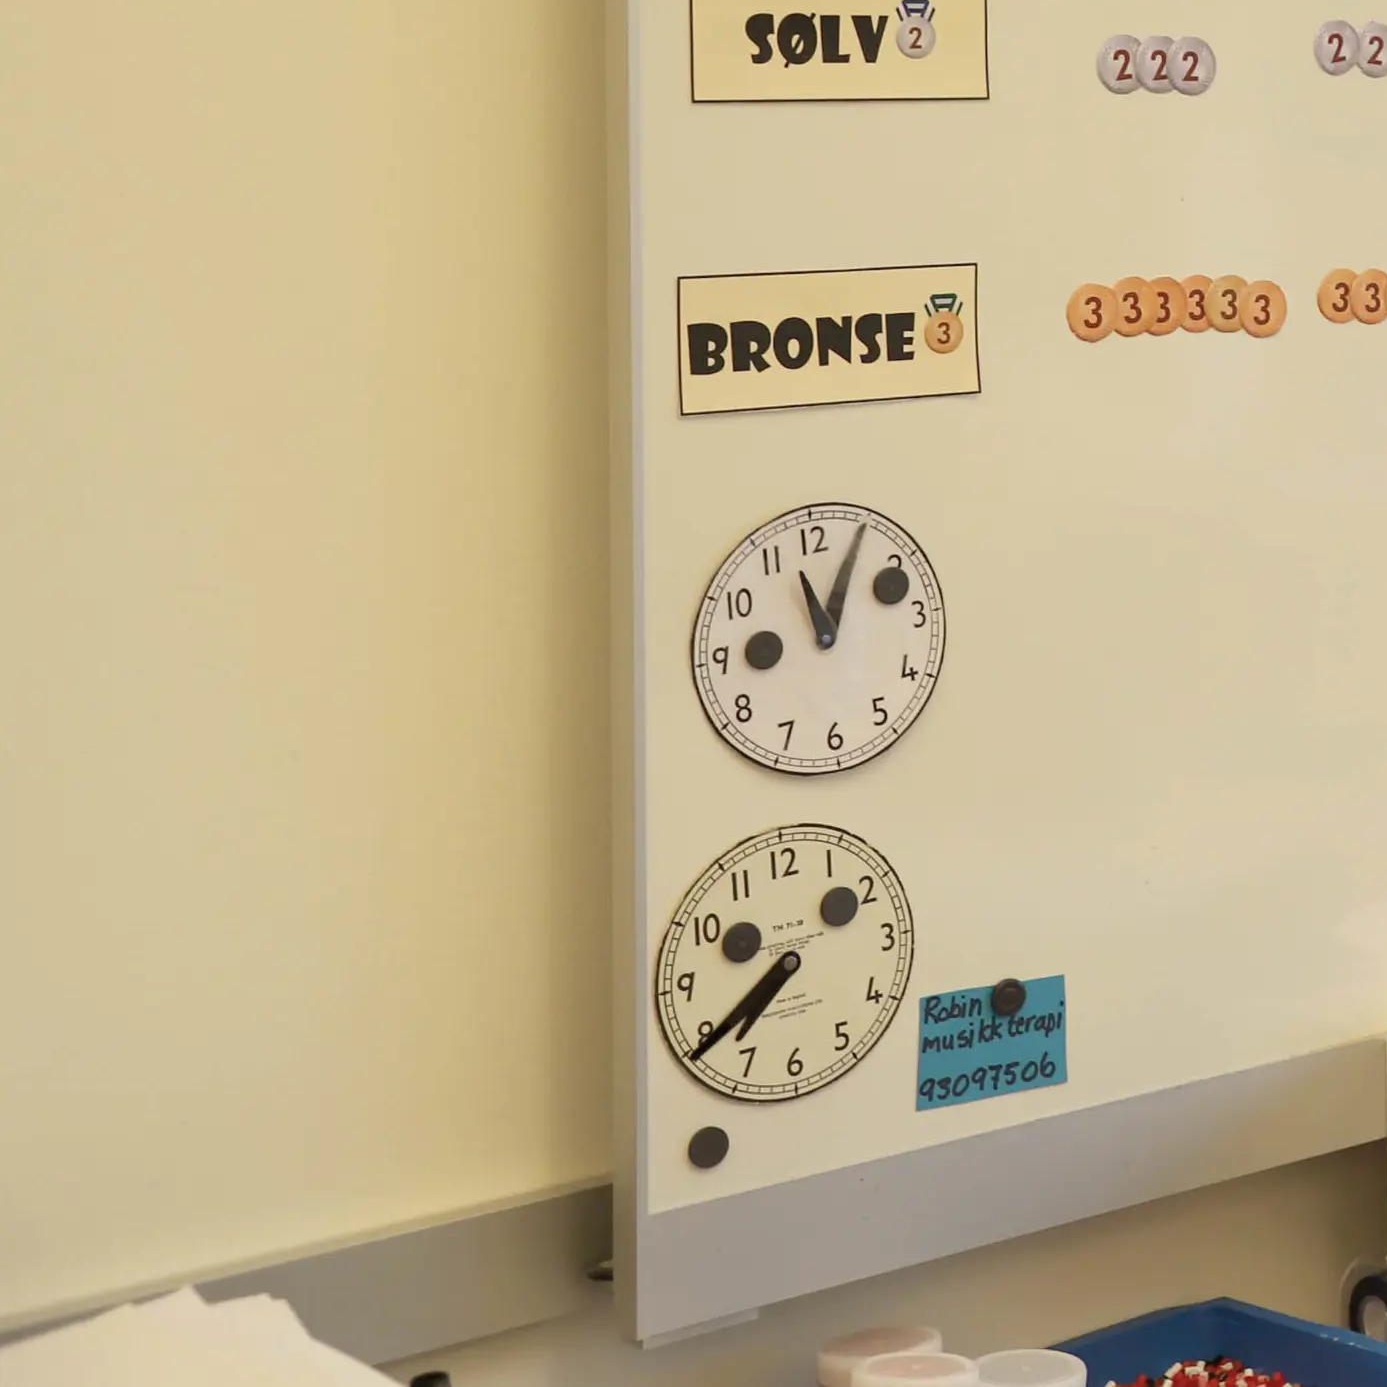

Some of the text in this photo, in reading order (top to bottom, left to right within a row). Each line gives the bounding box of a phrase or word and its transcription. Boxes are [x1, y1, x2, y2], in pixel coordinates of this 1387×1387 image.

[745, 11, 923, 69] SØLV 2
[1326, 31, 1386, 67] 2 2
[1111, 48, 1201, 83] 2 2 2
[1082, 287, 1272, 330] 3 3 3 3 3 3
[1330, 280, 1352, 314] 3
[1363, 281, 1382, 315] 3
[687, 312, 952, 376] BRONSE 3
[799, 525, 830, 556] 12
[762, 545, 782, 576] 11
[725, 588, 753, 621] 10
[912, 600, 927, 628] 3
[712, 646, 730, 675] 9
[900, 654, 919, 681] 4
[734, 693, 753, 723] 8
[871, 696, 889, 726] 5
[777, 720, 796, 751] 7
[826, 721, 844, 751] 6
[769, 847, 800, 880] 12
[825, 849, 834, 878] 1
[730, 868, 751, 901] 11
[858, 875, 878, 905] 2
[693, 912, 721, 946] 10
[880, 922, 895, 951] 3
[676, 971, 695, 1002] 9
[865, 976, 884, 1005] 4
[923, 995, 983, 1025] Robin
[834, 1021, 850, 1052] 5
[738, 1046, 757, 1078] 7
[786, 1047, 804, 1077] 6
[918, 1051, 1057, 1103] 93097506
